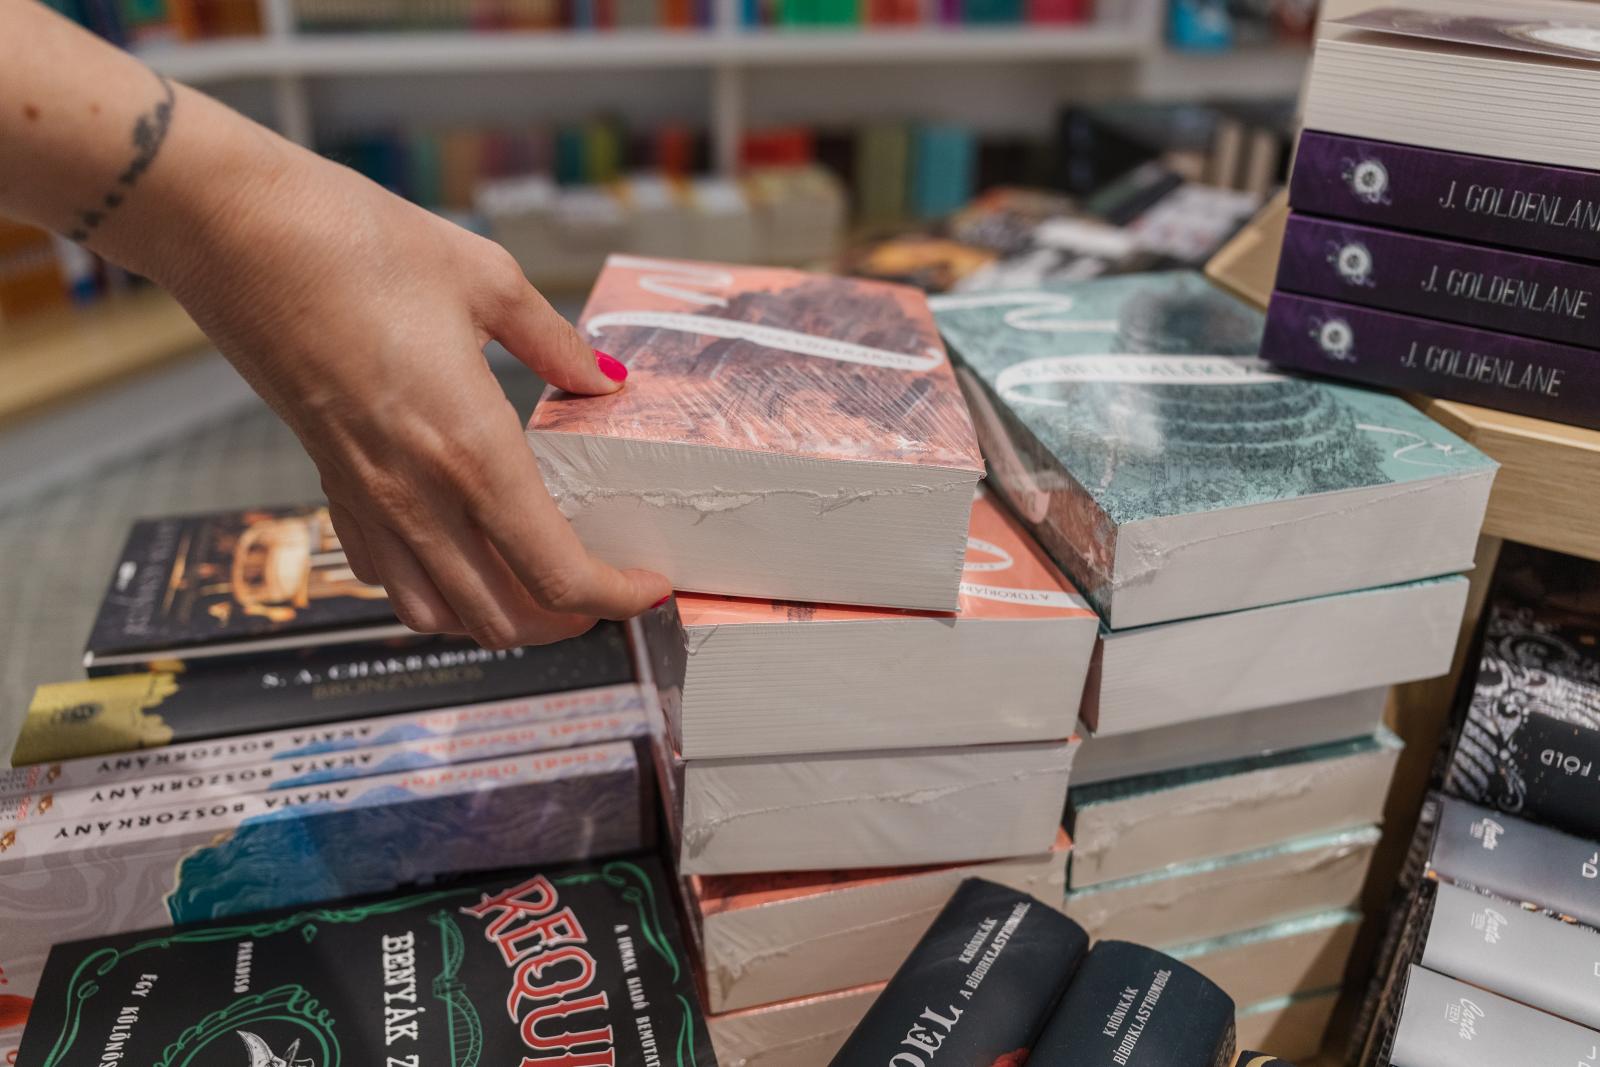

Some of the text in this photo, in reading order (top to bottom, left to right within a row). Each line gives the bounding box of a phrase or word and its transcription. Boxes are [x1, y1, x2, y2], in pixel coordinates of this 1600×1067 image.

[1439, 180, 1600, 232] J. GOLDENLAN
[1421, 265, 1593, 319] J. GOLDENLANE
[1401, 341, 1566, 397] J. GOLDENLANE
[293, 726, 371, 745] AKATA
[90, 754, 372, 802] AKATA BOSZORKÁNY
[1540, 749, 1592, 776] FÖLD
[264, 788, 349, 808] AKATA
[54, 803, 245, 839] BOSZORKÁNY
[958, 916, 998, 964] KRÓNIKÁK
[130, 973, 159, 998] EGY
[233, 941, 254, 994] PARADISO
[381, 930, 427, 1046] BENYÁK
[626, 976, 650, 1010] KIADÓ
[959, 988, 972, 1000] A
[1101, 985, 1139, 1038] KRÓNIKÁK
[1448, 1003, 1461, 1025] TEEN
[1112, 968, 1172, 1066] BÍBORKLASTROMBÓL
[1459, 998, 1485, 1041] Carta
